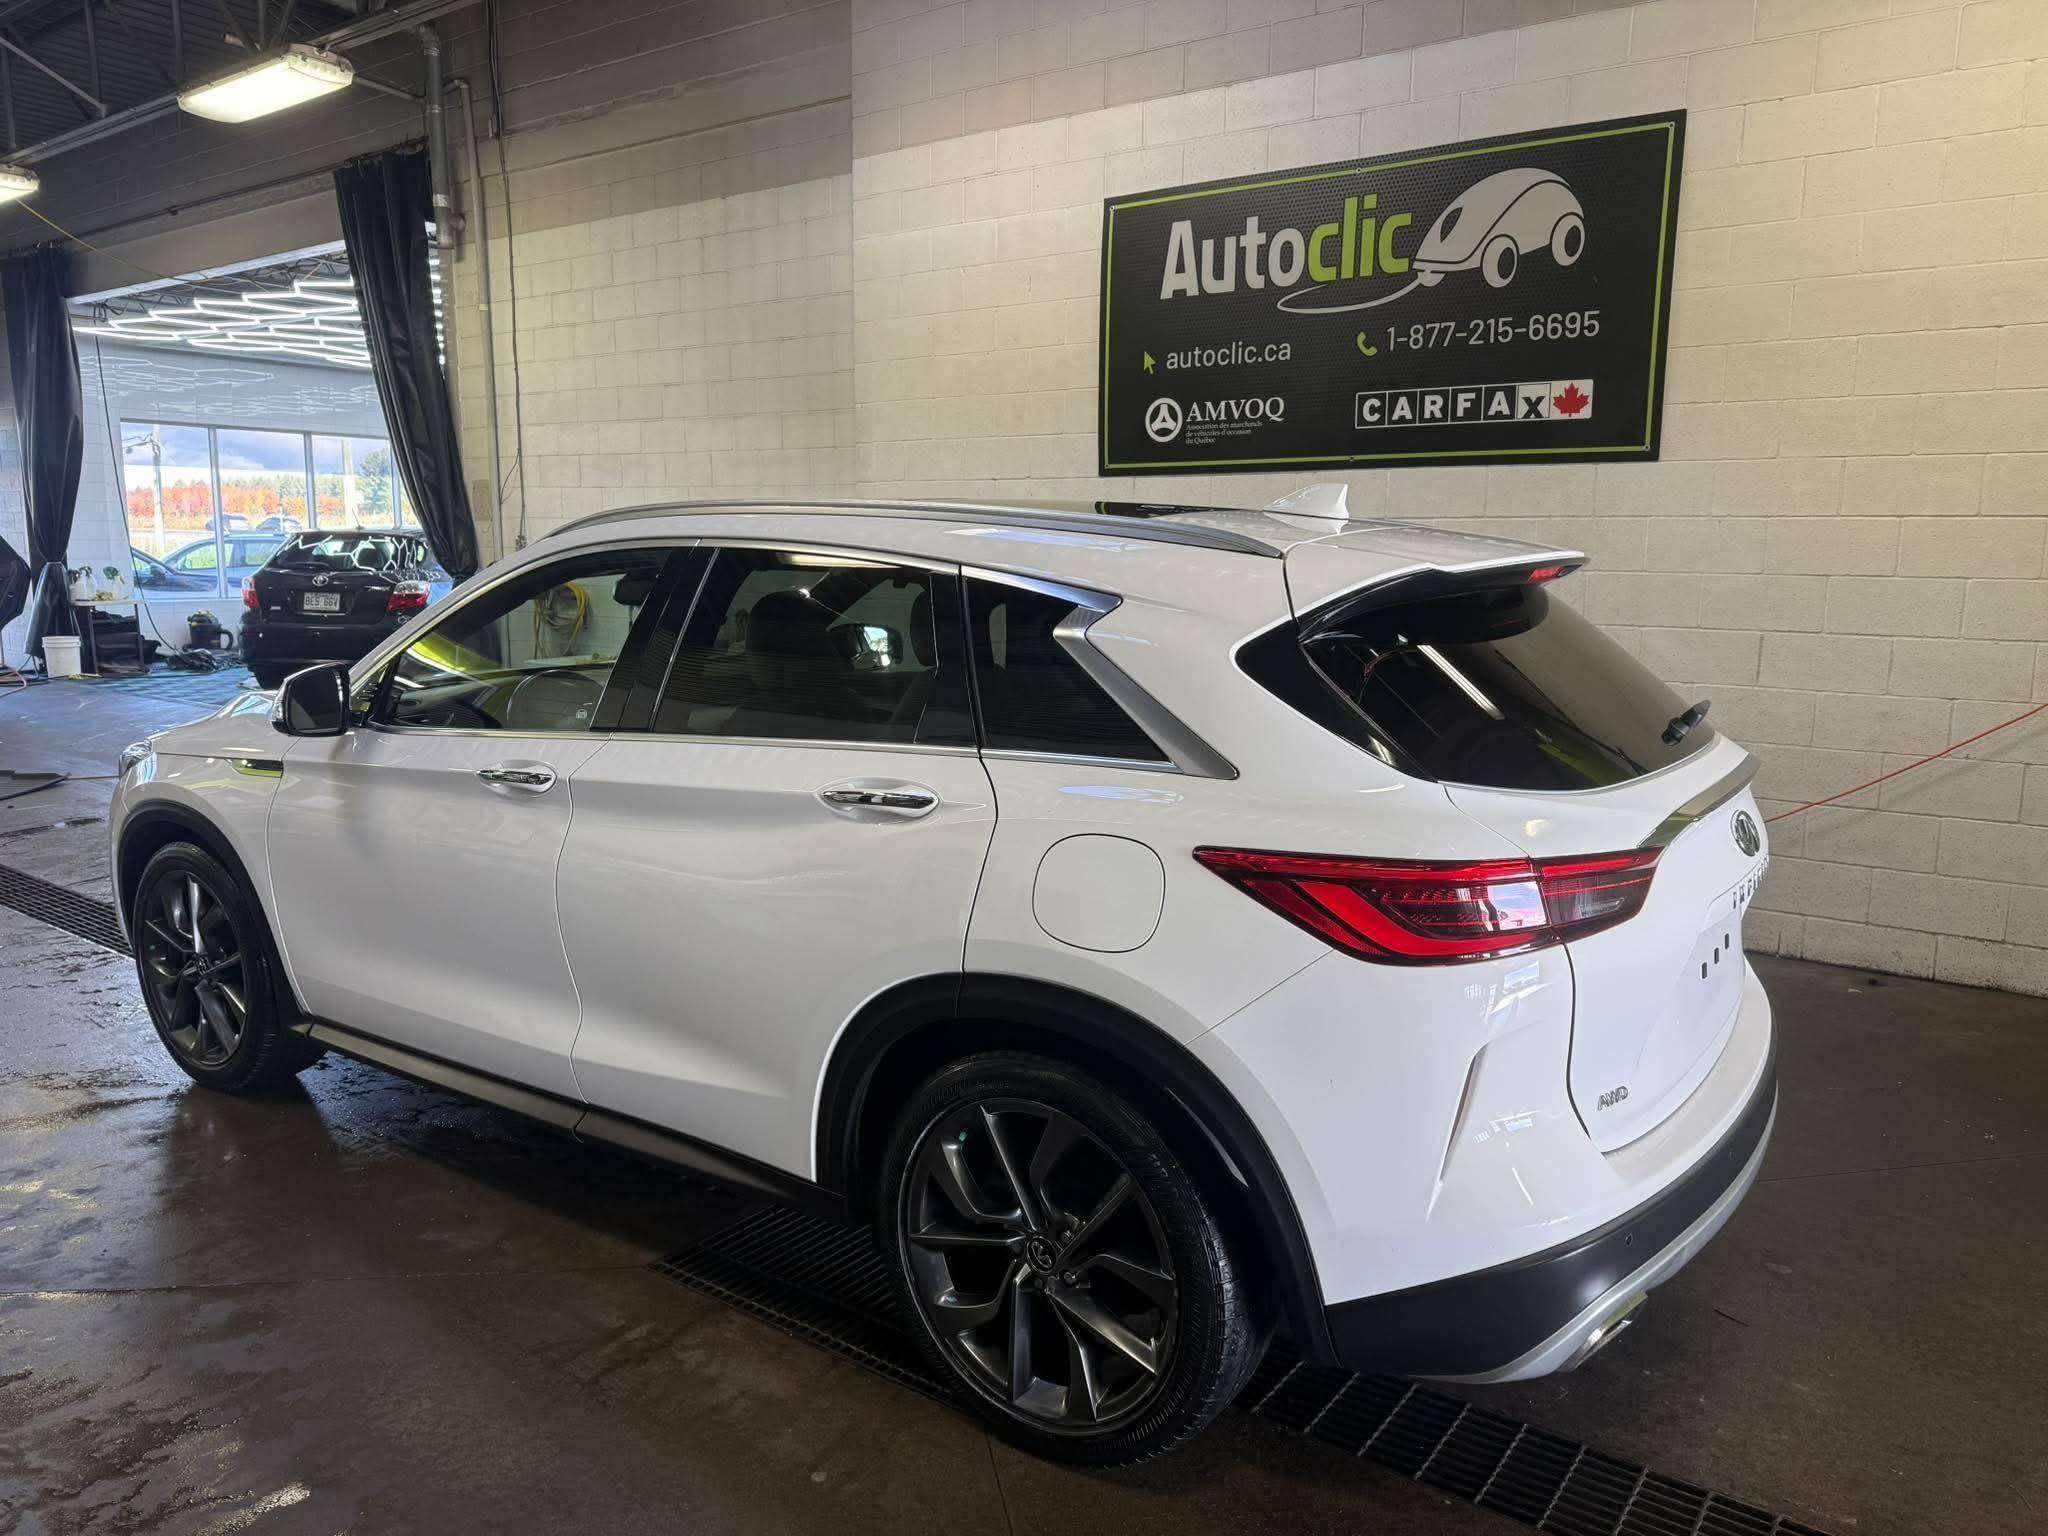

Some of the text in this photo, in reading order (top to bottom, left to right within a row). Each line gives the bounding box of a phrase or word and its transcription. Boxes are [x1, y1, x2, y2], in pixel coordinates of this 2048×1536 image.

[1160, 192, 1412, 300] Autoclic
[1386, 310, 1601, 351] 1-877-215-6695
[1166, 341, 1291, 369] autoclic.ca
[1186, 396, 1285, 422] AMVOQ
[1361, 390, 1546, 423] CARFAX
[1597, 1085, 1629, 1111] AWD
